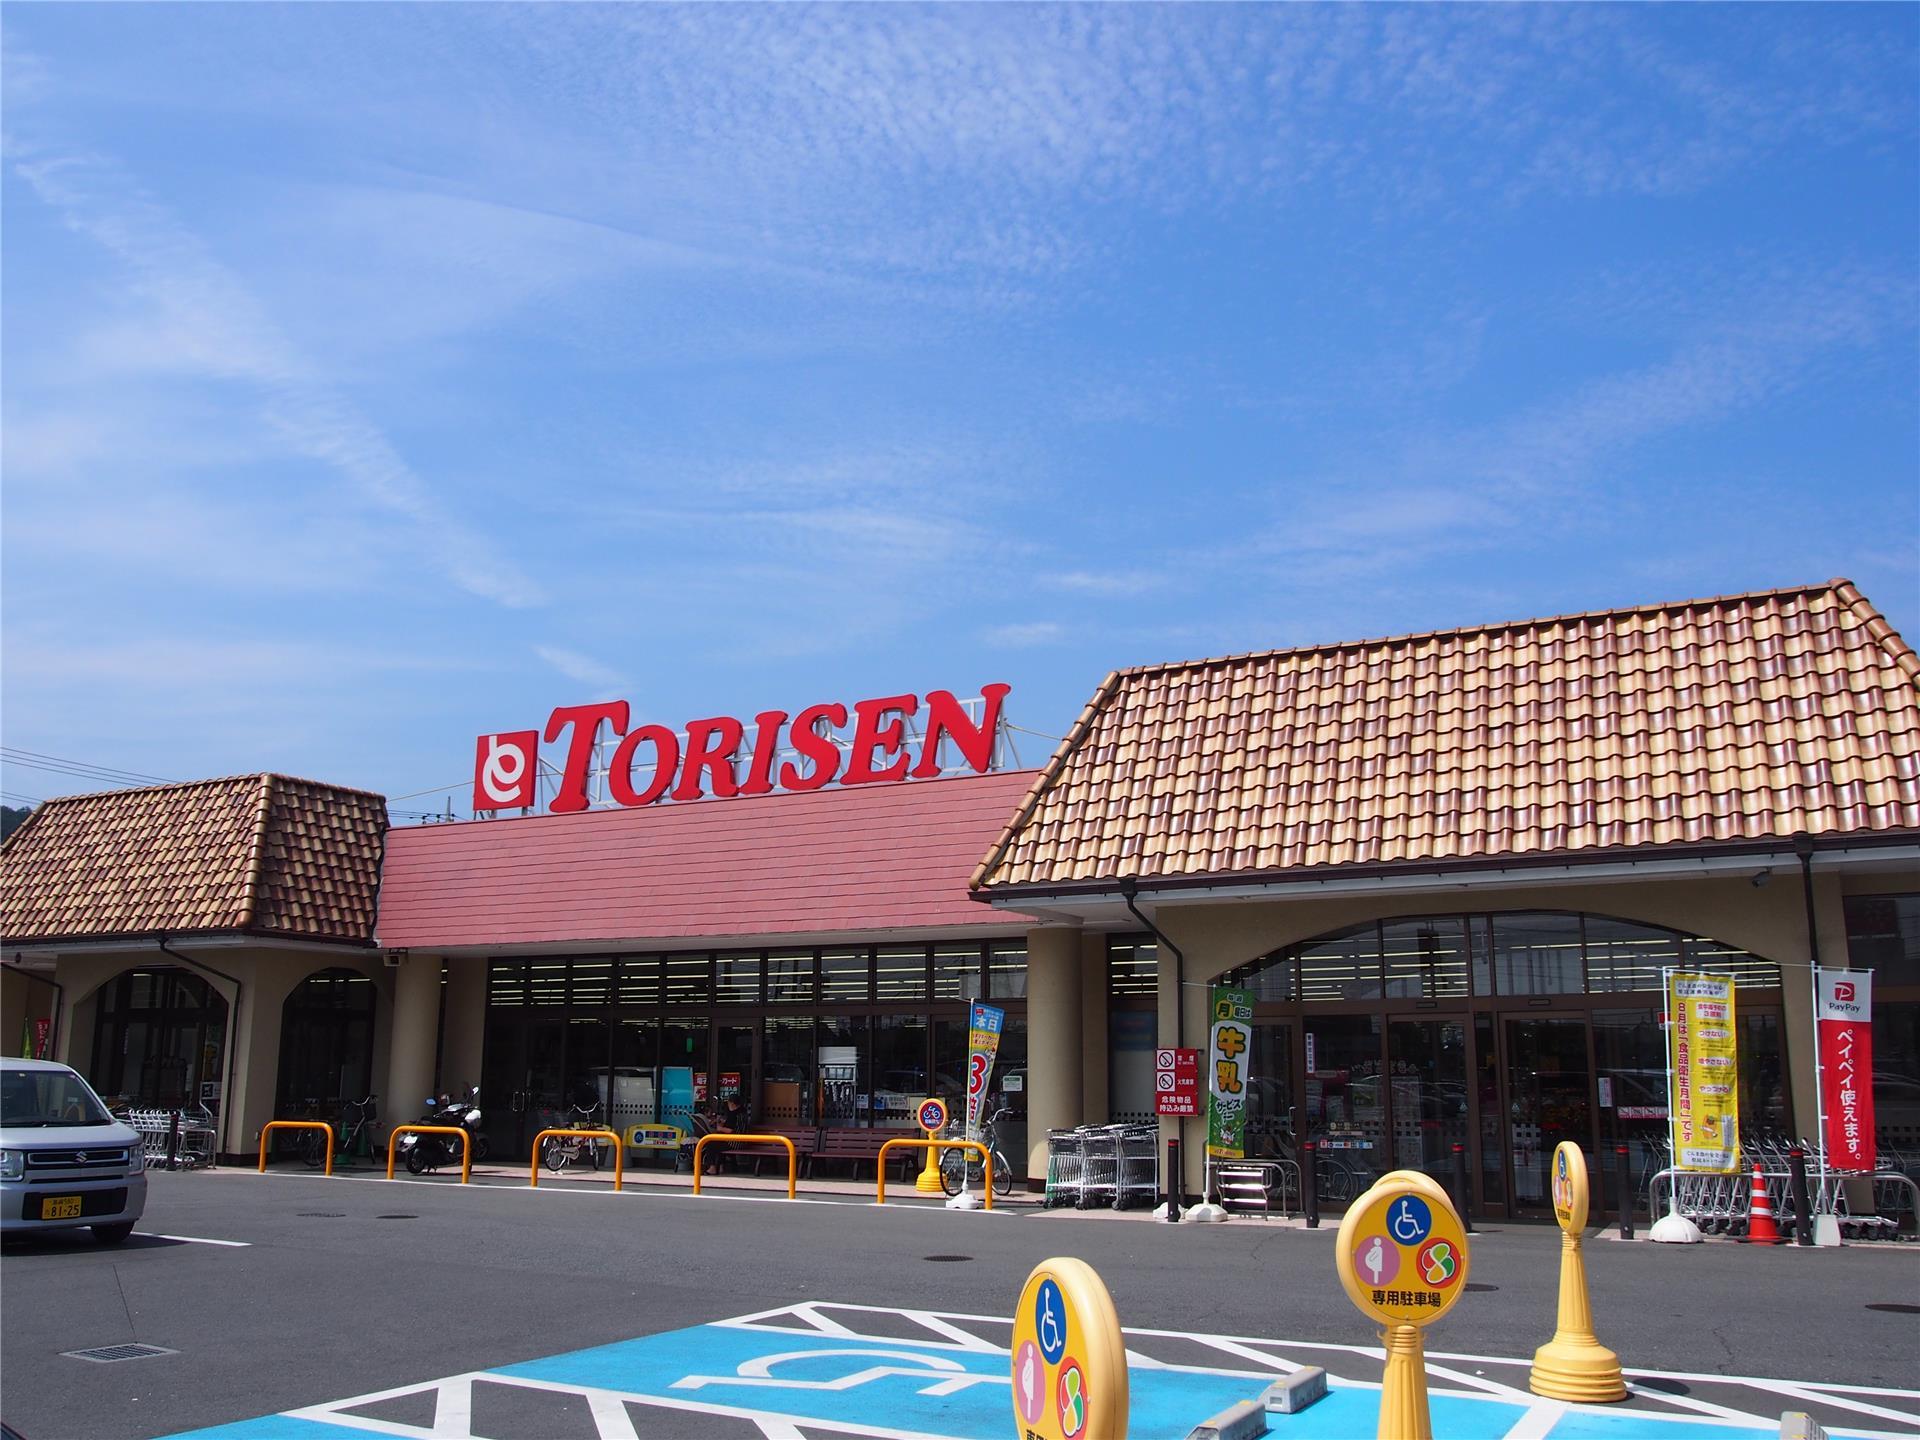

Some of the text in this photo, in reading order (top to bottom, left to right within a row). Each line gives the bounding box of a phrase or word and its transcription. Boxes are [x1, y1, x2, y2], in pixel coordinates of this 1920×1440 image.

[544, 683, 1012, 812] TORISEN
[1829, 1002, 1860, 1012] PayPay
[1216, 1026, 1246, 1095] 牛乳
[1837, 1029, 1861, 1160] ペイペイ使えます。
[1372, 1290, 1441, 1307] 専用駐車場
